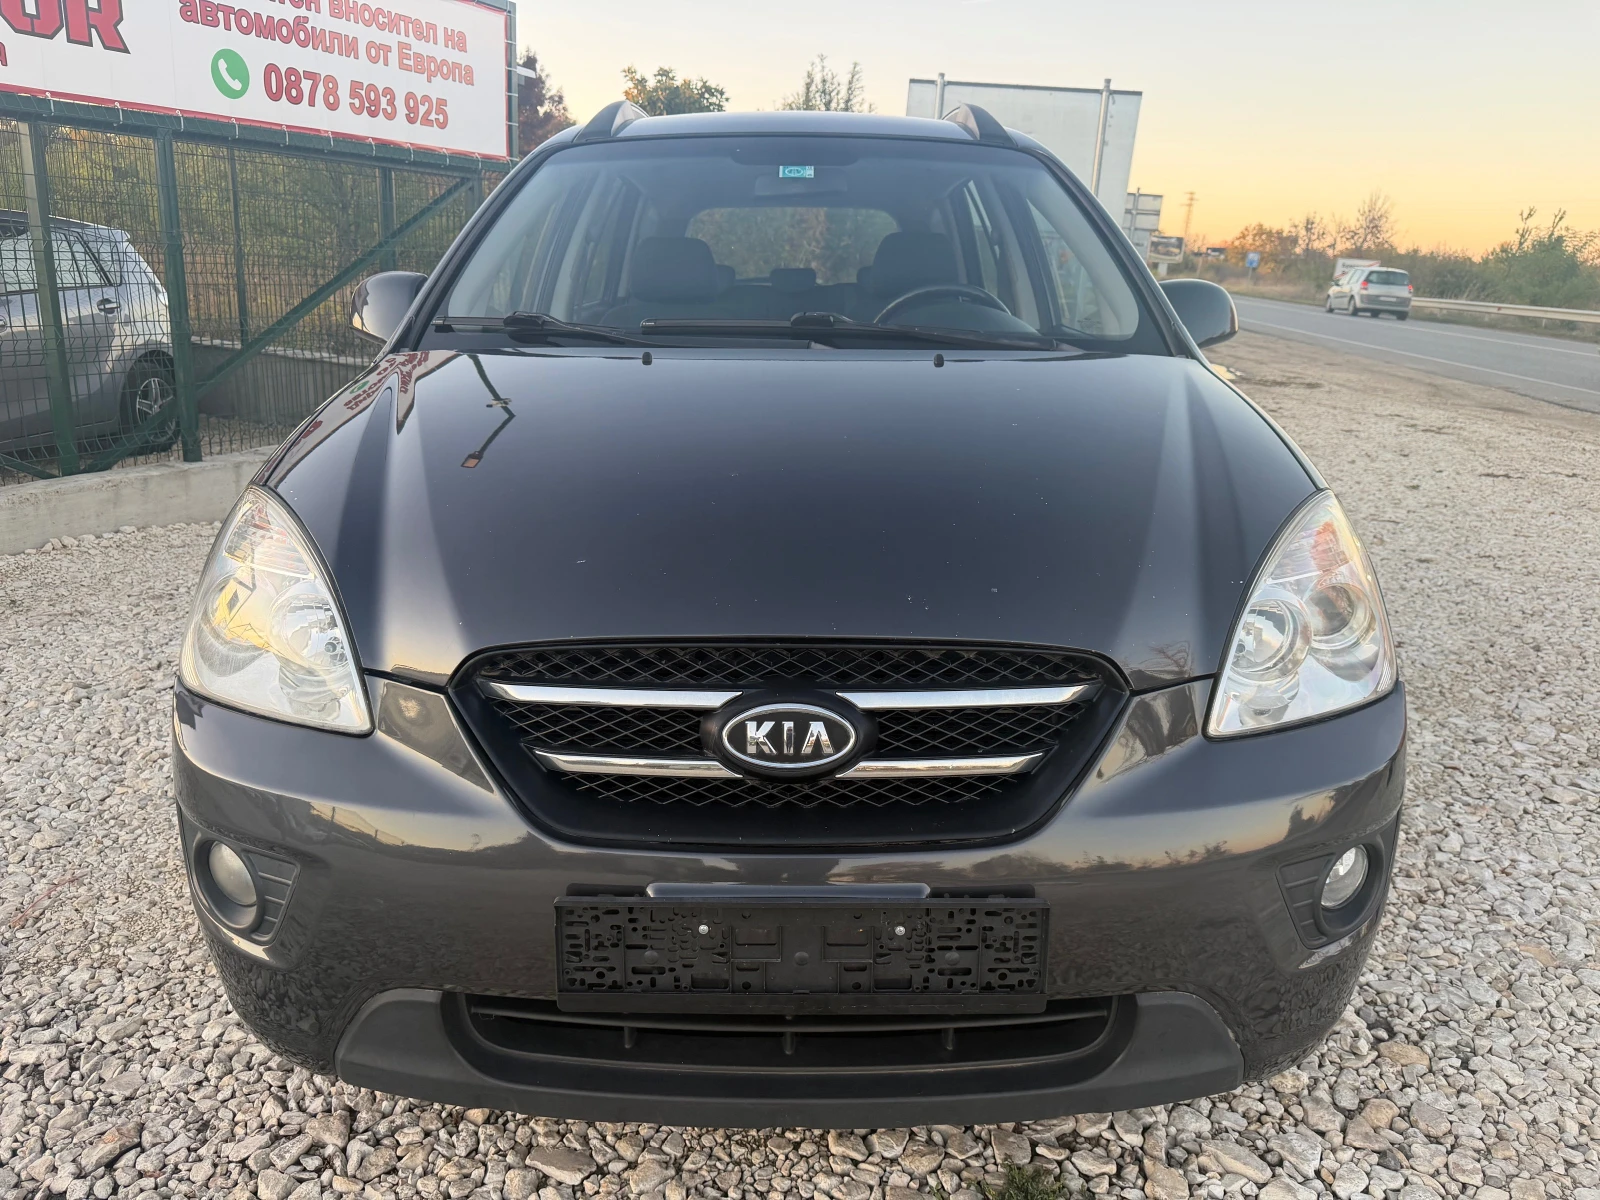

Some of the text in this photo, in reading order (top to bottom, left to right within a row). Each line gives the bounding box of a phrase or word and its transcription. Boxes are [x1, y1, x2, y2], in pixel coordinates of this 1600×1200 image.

[179, 0, 475, 86] автомобили от Европа
[329, 0, 468, 53] вносител на
[263, 62, 449, 130] 0878 593 925
[744, 721, 834, 755] KIA
